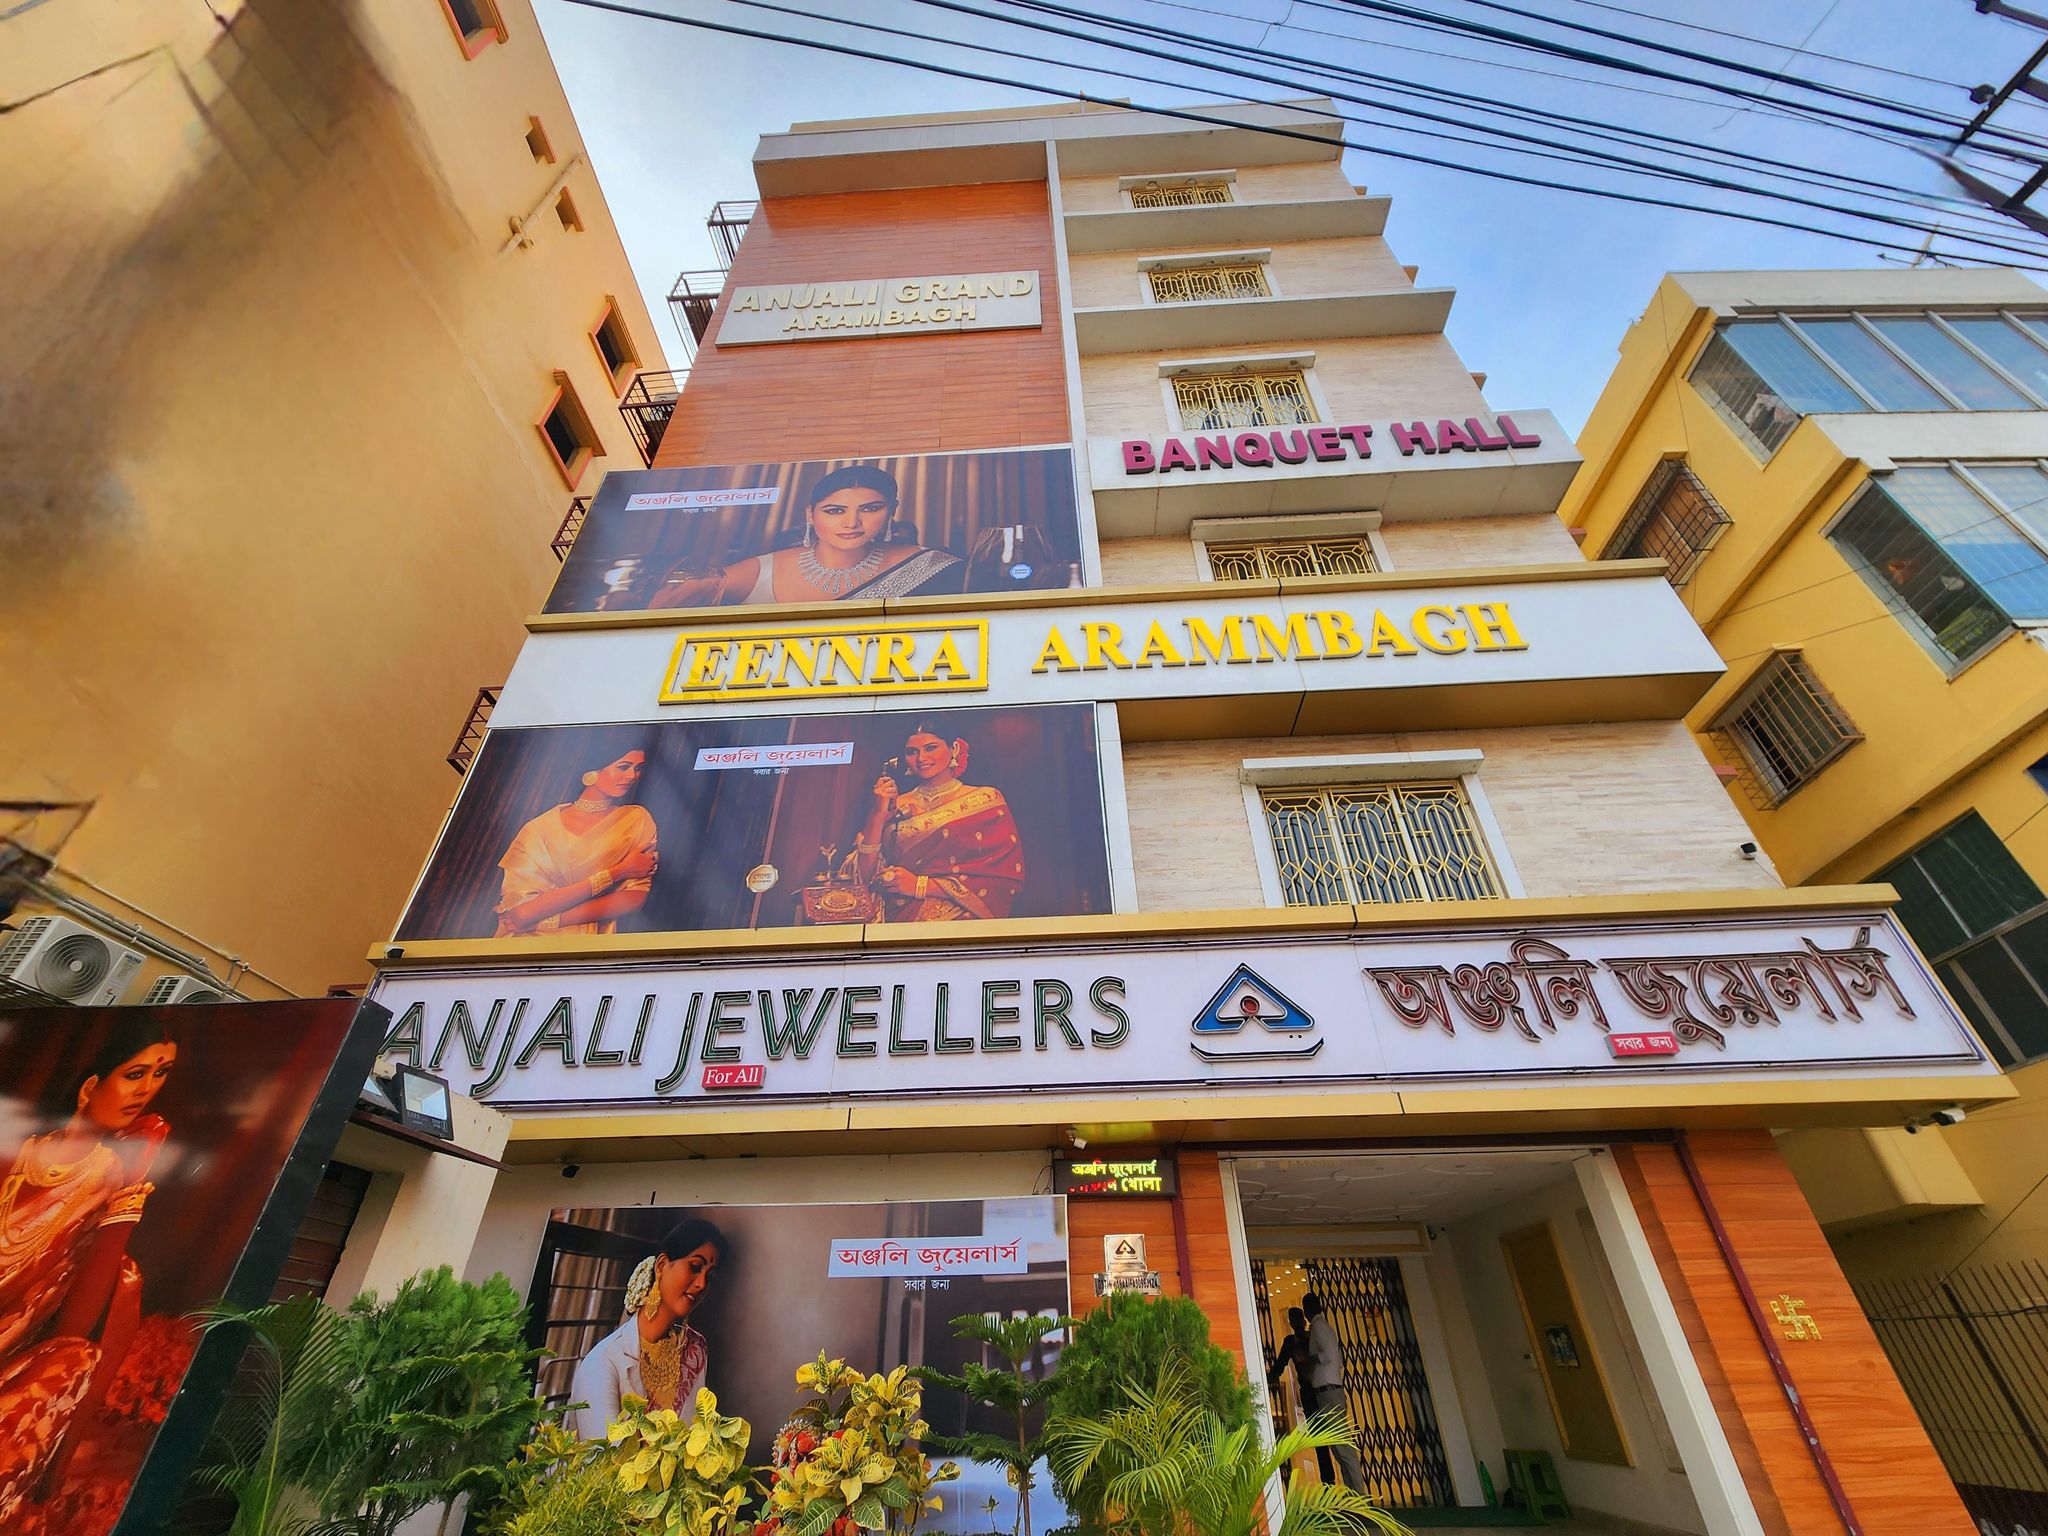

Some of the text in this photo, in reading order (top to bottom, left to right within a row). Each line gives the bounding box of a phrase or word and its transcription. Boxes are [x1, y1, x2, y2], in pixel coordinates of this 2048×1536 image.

[733, 274, 1033, 312] ANJALI GRAND
[782, 303, 977, 332] ARAMBAGH
[1121, 415, 1542, 475] BANQUET HALL
[634, 493, 689, 505] অঞ্জলি
[1031, 602, 1530, 673] ARAMMBAGH
[681, 630, 971, 692] EENNRA
[703, 744, 849, 764] অঞ্জলি জুয়েলার্স
[1362, 927, 1917, 1051] অঞ্জলি জুয়েলার্স
[378, 976, 1131, 1098] ANJALI JEWELLERS
[1616, 1035, 1673, 1050] সবার জন্য
[706, 1066, 760, 1084] For All
[837, 1238, 1022, 1272] অঞ্জলি জুয়েলার্স
[904, 1279, 950, 1291] সবার জন্য
